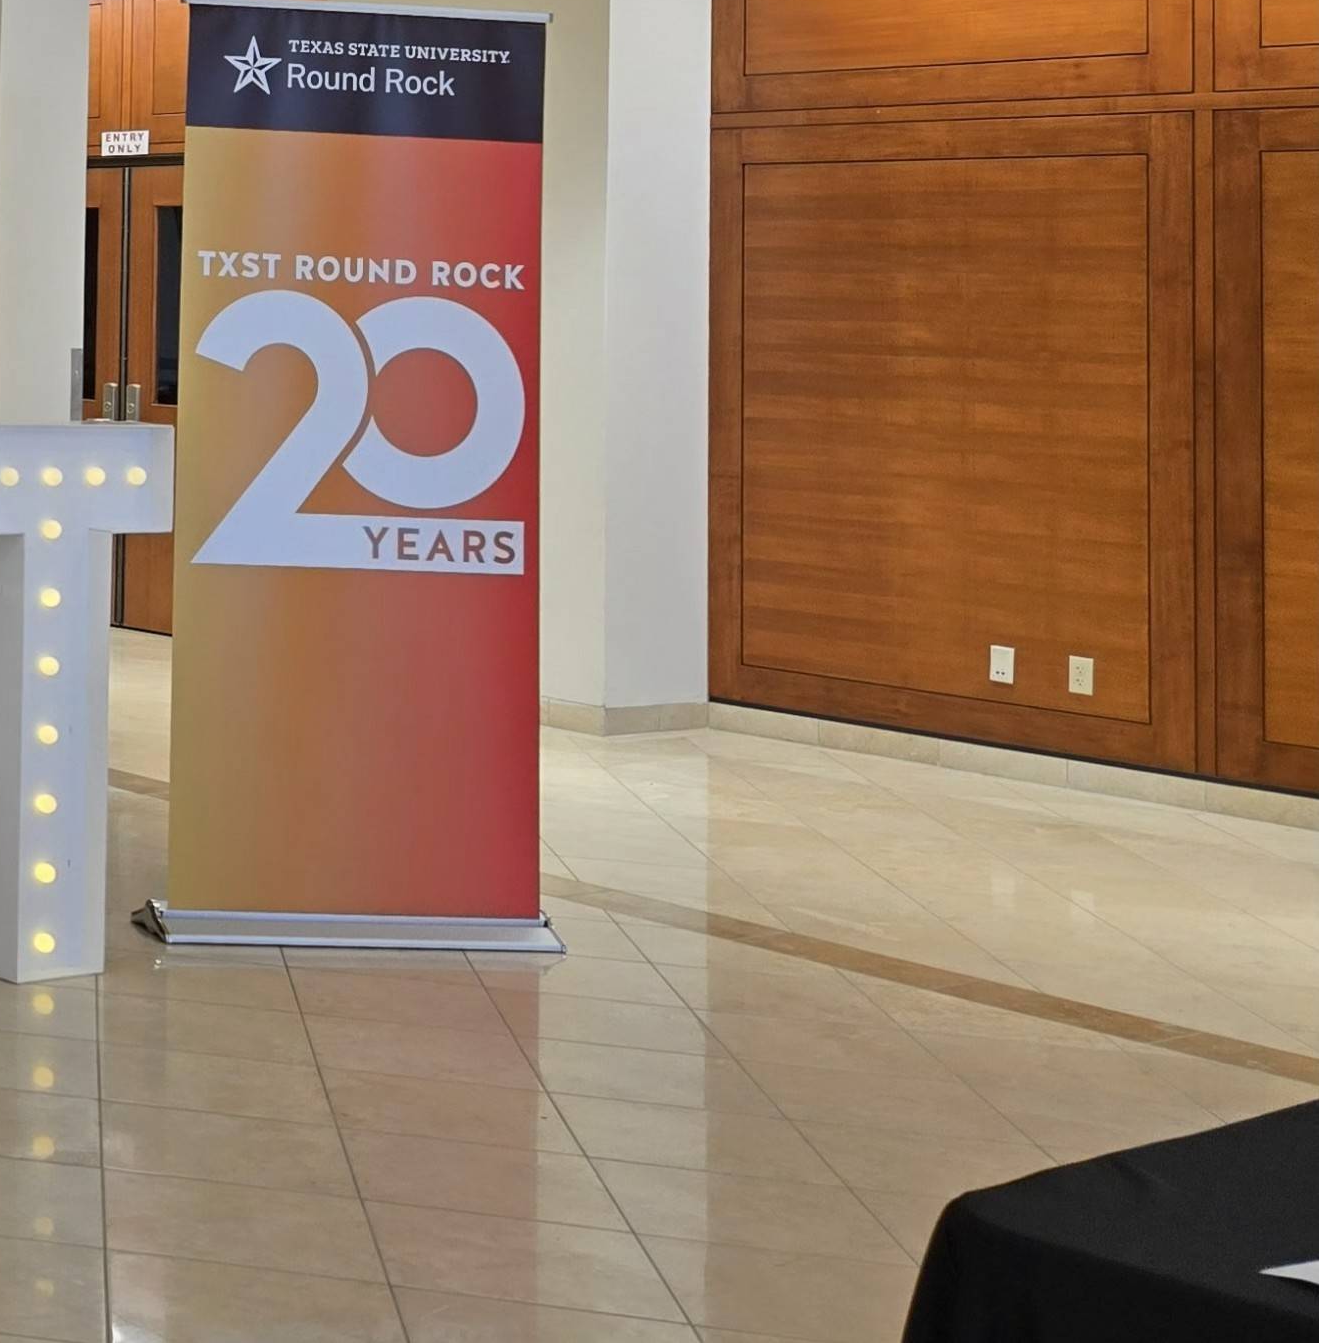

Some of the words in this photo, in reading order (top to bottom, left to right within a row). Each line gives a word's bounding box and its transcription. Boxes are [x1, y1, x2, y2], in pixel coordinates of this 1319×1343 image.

[288, 39, 345, 55] TEXAS
[347, 42, 401, 58] STATE
[404, 45, 510, 64] UNIVERSITY
[286, 62, 376, 93] Round
[384, 67, 456, 97] Rock
[105, 132, 145, 143] ENTRY
[107, 144, 142, 154] ONLY
[197, 249, 283, 281] TXST
[294, 255, 418, 286] ROUND
[430, 260, 526, 291] ROCK
[189, 289, 526, 576] 20
[361, 524, 518, 566] YEARS
